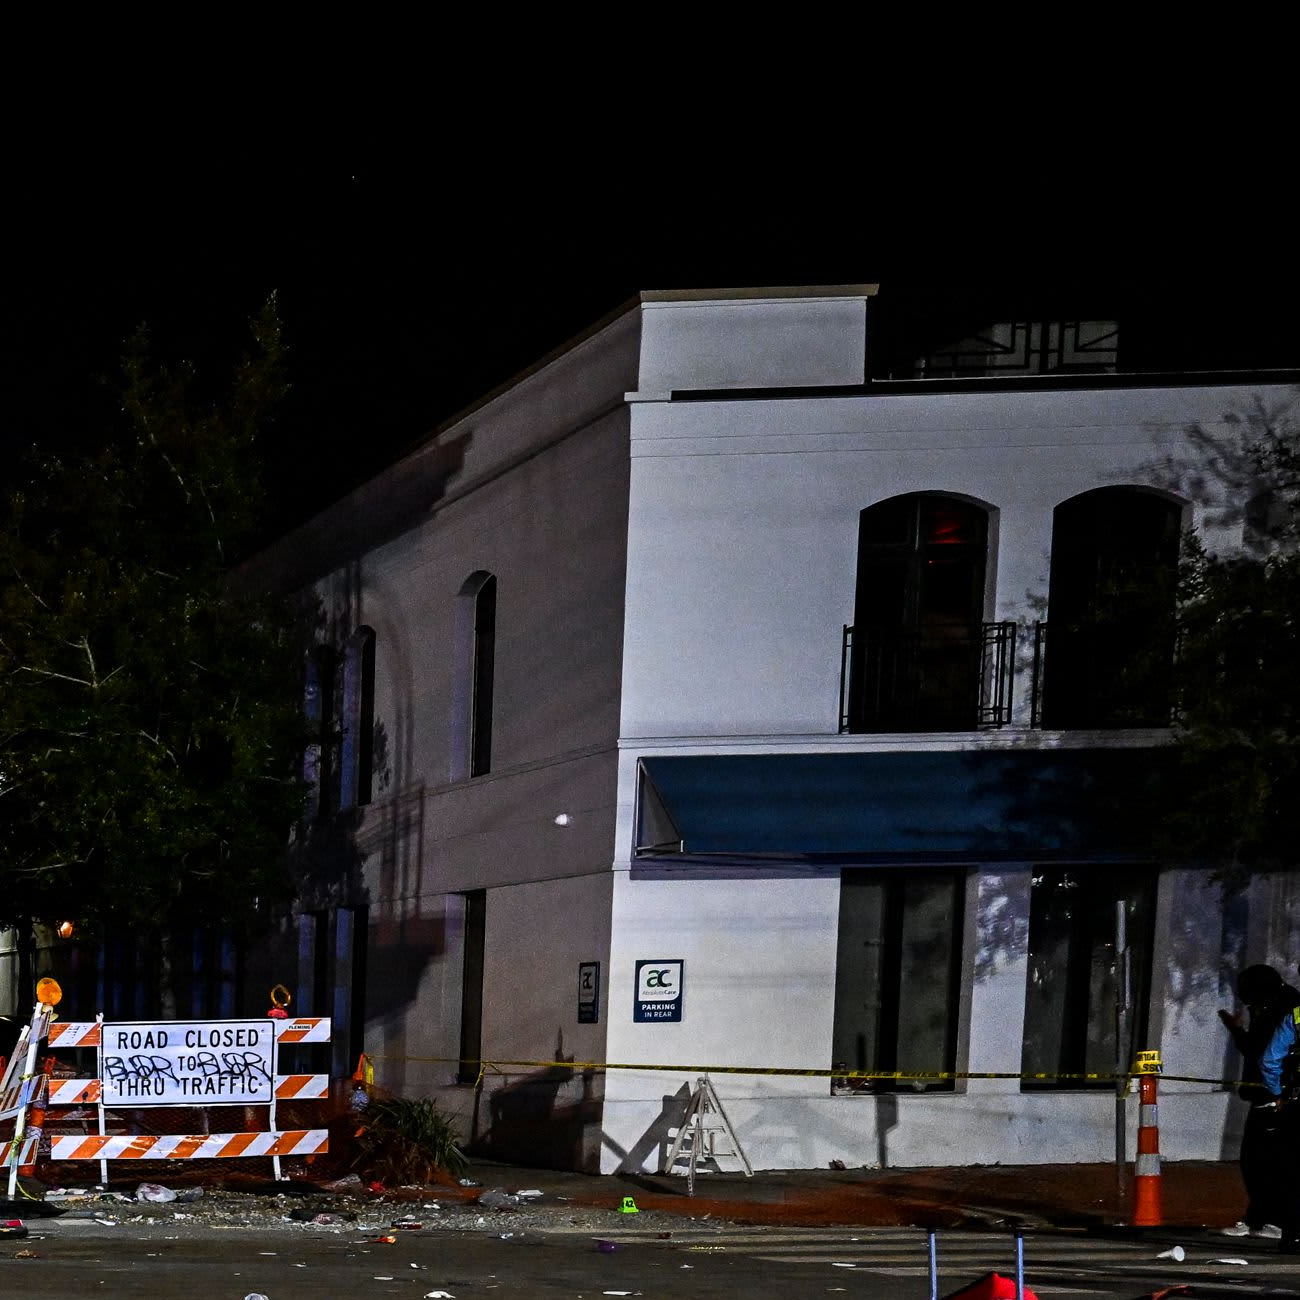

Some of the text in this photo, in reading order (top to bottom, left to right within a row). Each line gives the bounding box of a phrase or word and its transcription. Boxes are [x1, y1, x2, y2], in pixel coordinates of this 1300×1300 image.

[117, 1029, 259, 1049] ROAD CLOSED
[177, 1056, 197, 1071] TO
[116, 1075, 258, 1097] THRU TRAFFIC
